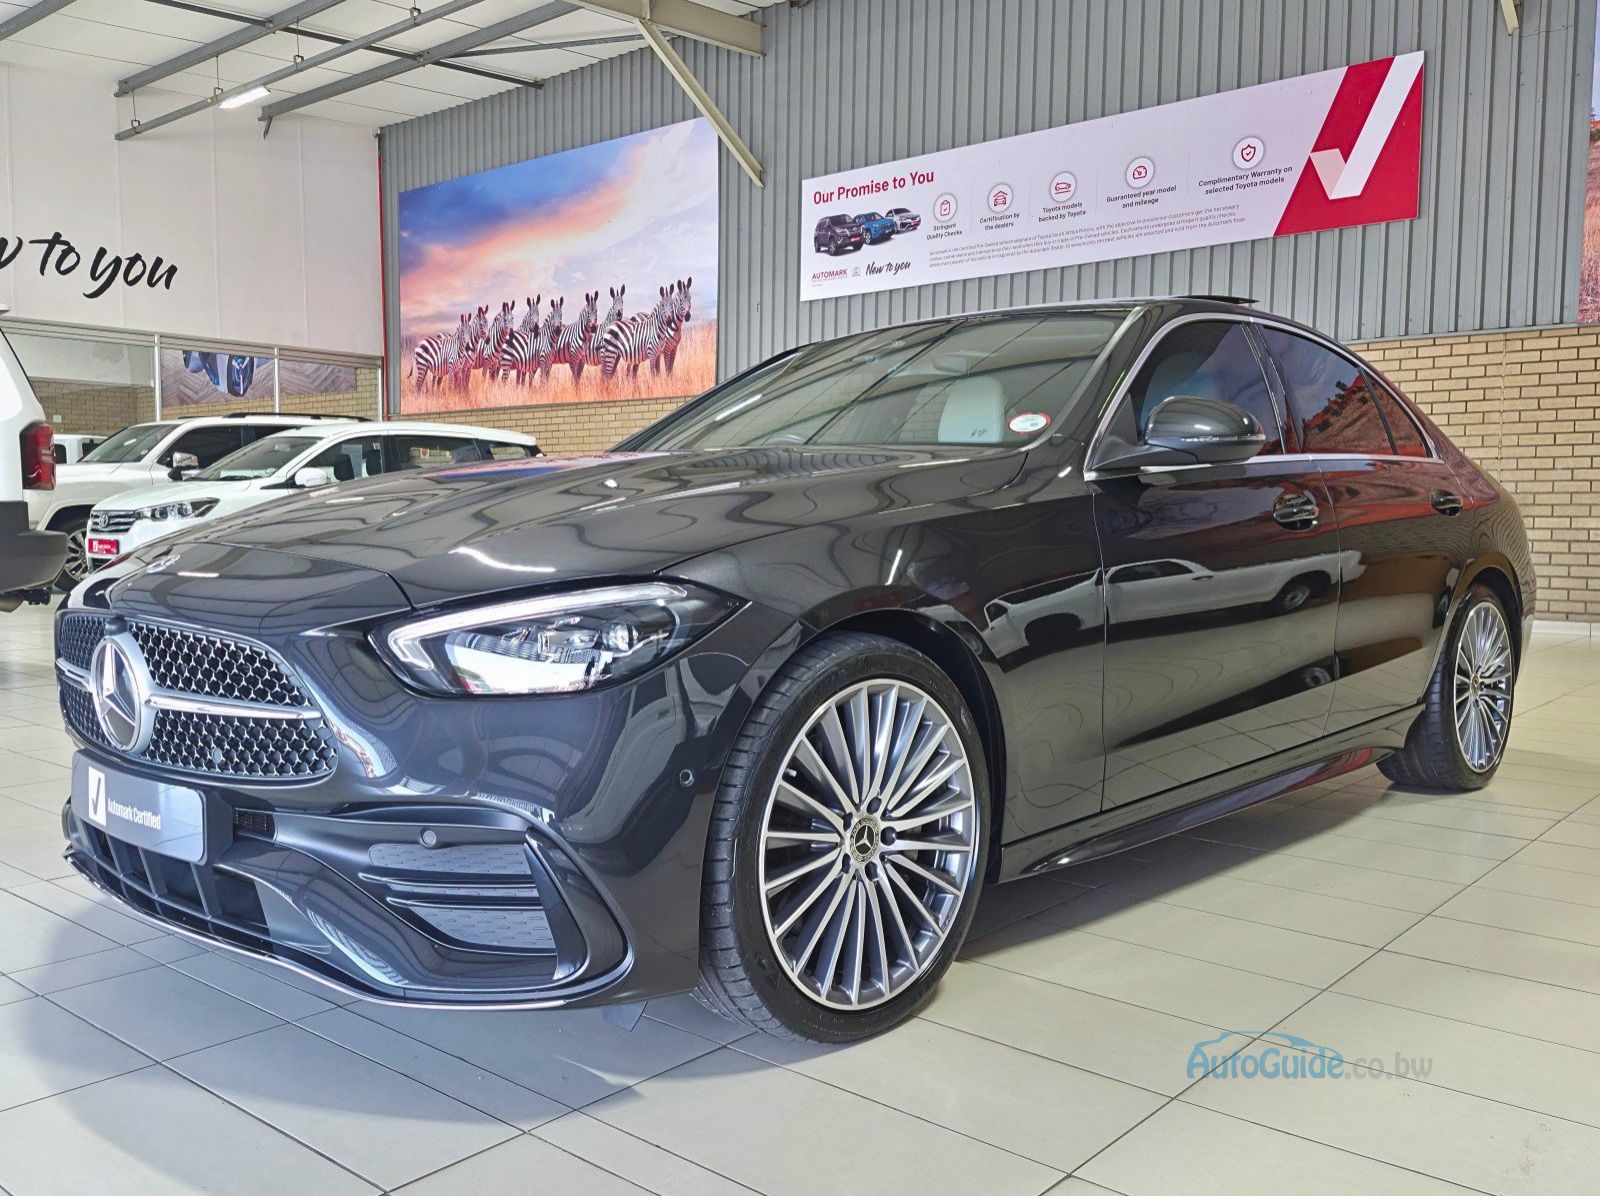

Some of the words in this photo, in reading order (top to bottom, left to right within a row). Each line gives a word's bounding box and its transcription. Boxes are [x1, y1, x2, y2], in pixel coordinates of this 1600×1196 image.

[1198, 174, 1249, 187] Complimentary
[1250, 168, 1282, 178] Warranty
[813, 191, 834, 204] Our
[837, 180, 889, 200] Promise
[893, 176, 905, 189] to
[910, 171, 934, 186] You
[1205, 186, 1234, 194] selected
[1236, 182, 1257, 191] Toyota
[1259, 176, 1284, 185] models
[1106, 192, 1141, 202] Guaranteed
[1142, 190, 1156, 198] year
[1156, 185, 1176, 194] model
[1043, 205, 1061, 214] Toyota
[1062, 202, 1082, 211] models
[1134, 197, 1159, 206] mileage
[980, 213, 1012, 223] Certification
[1014, 212, 1020, 220] by
[1038, 213, 1058, 223] backed
[1068, 210, 1086, 219] Toyota
[933, 223, 956, 231] Stringent
[995, 222, 1014, 230] dealers
[29, 232, 81, 276] to
[82, 246, 178, 298] you
[866, 262, 883, 275] New
[884, 262, 894, 272] to
[894, 261, 911, 275] you
[812, 269, 848, 280] AUTOMARK
[108, 798, 133, 821] Automark
[134, 807, 161, 831] Certified
